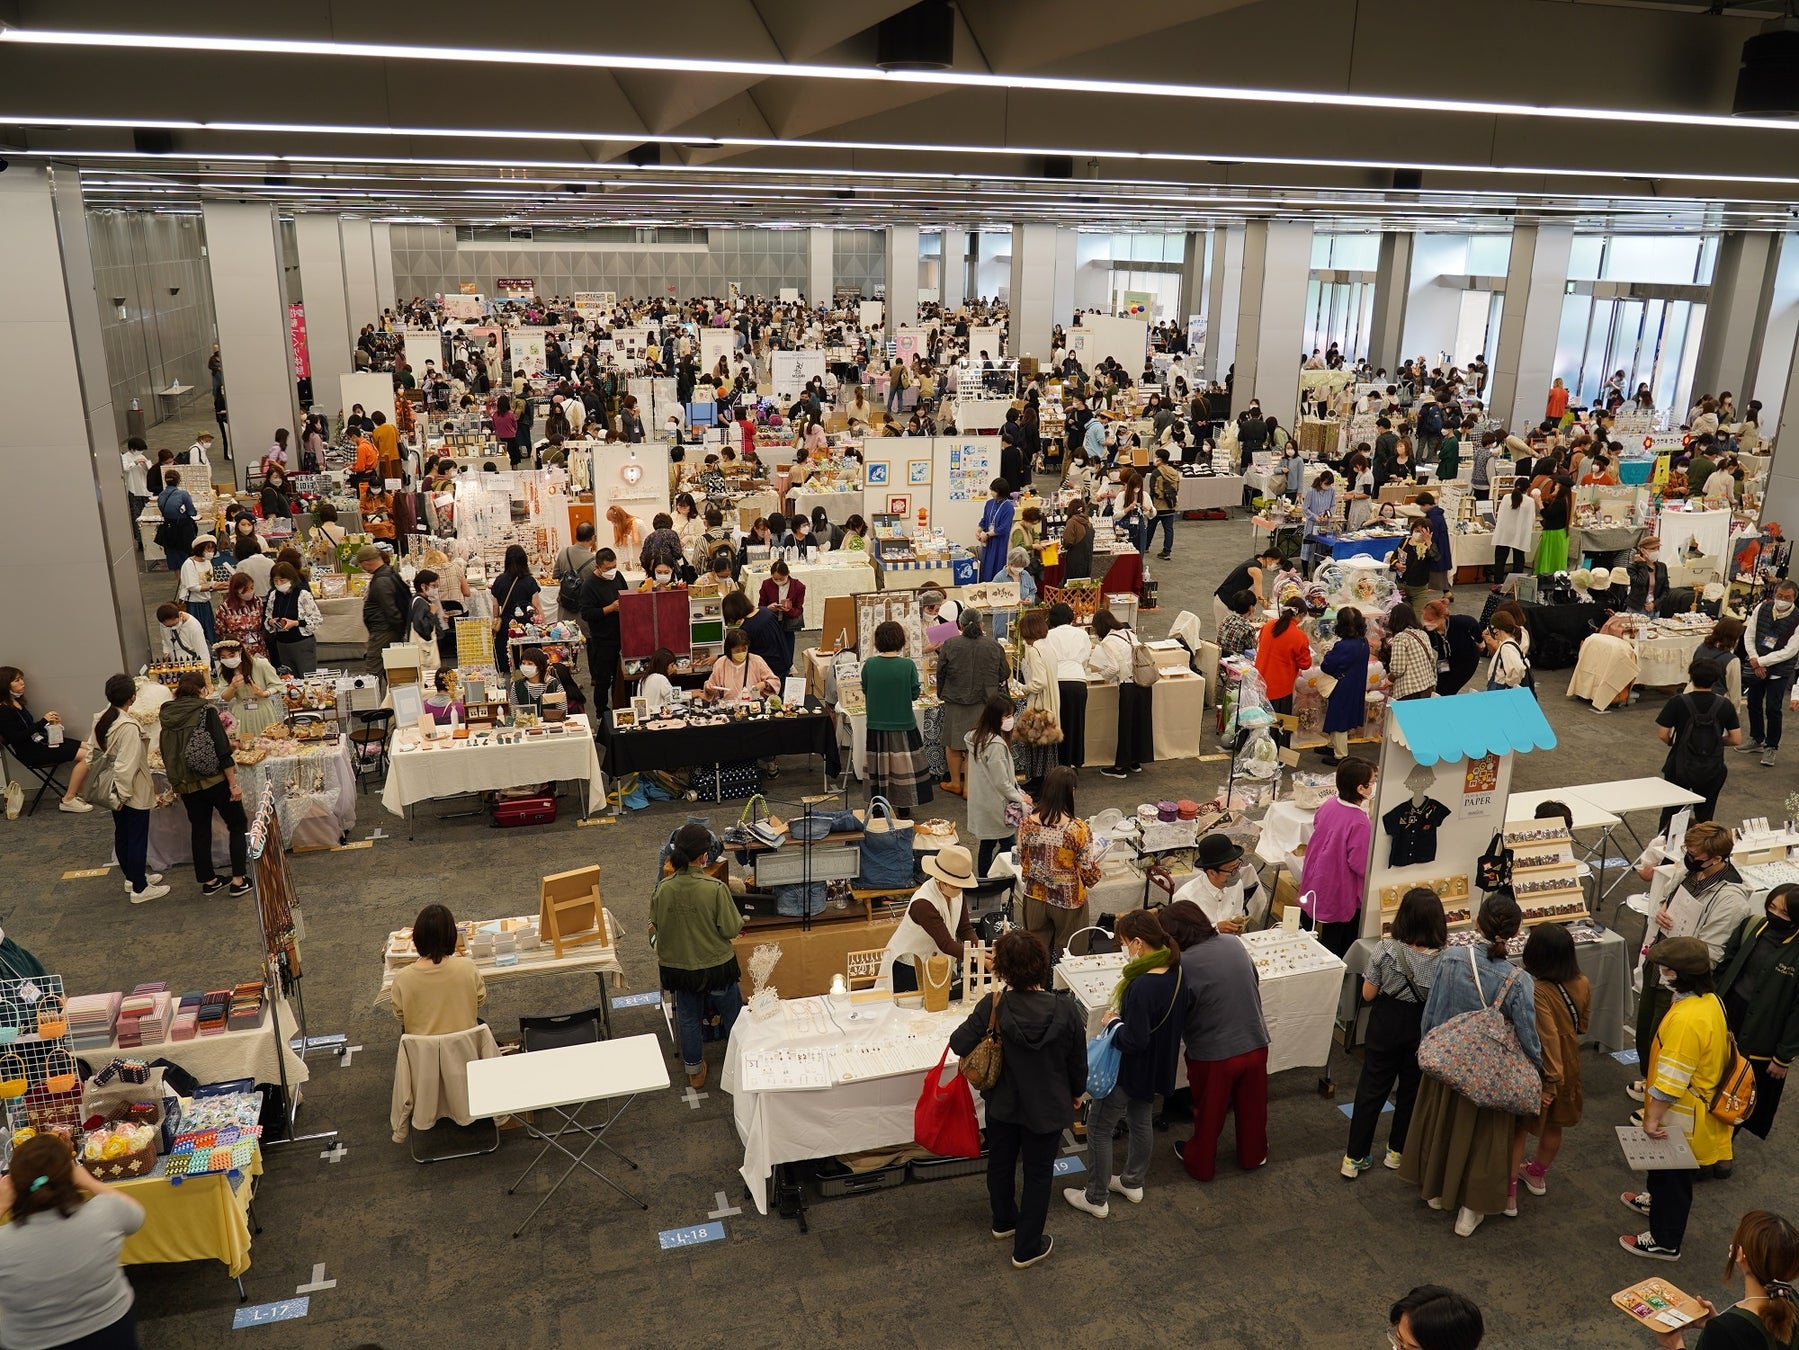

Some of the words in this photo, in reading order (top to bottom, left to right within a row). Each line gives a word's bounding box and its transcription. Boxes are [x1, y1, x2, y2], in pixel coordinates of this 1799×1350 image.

[1464, 797, 1491, 807] PAPER
[1054, 1162, 1068, 1171] 19
[677, 1229, 707, 1242] L-18
[254, 1305, 289, 1320] L-17
